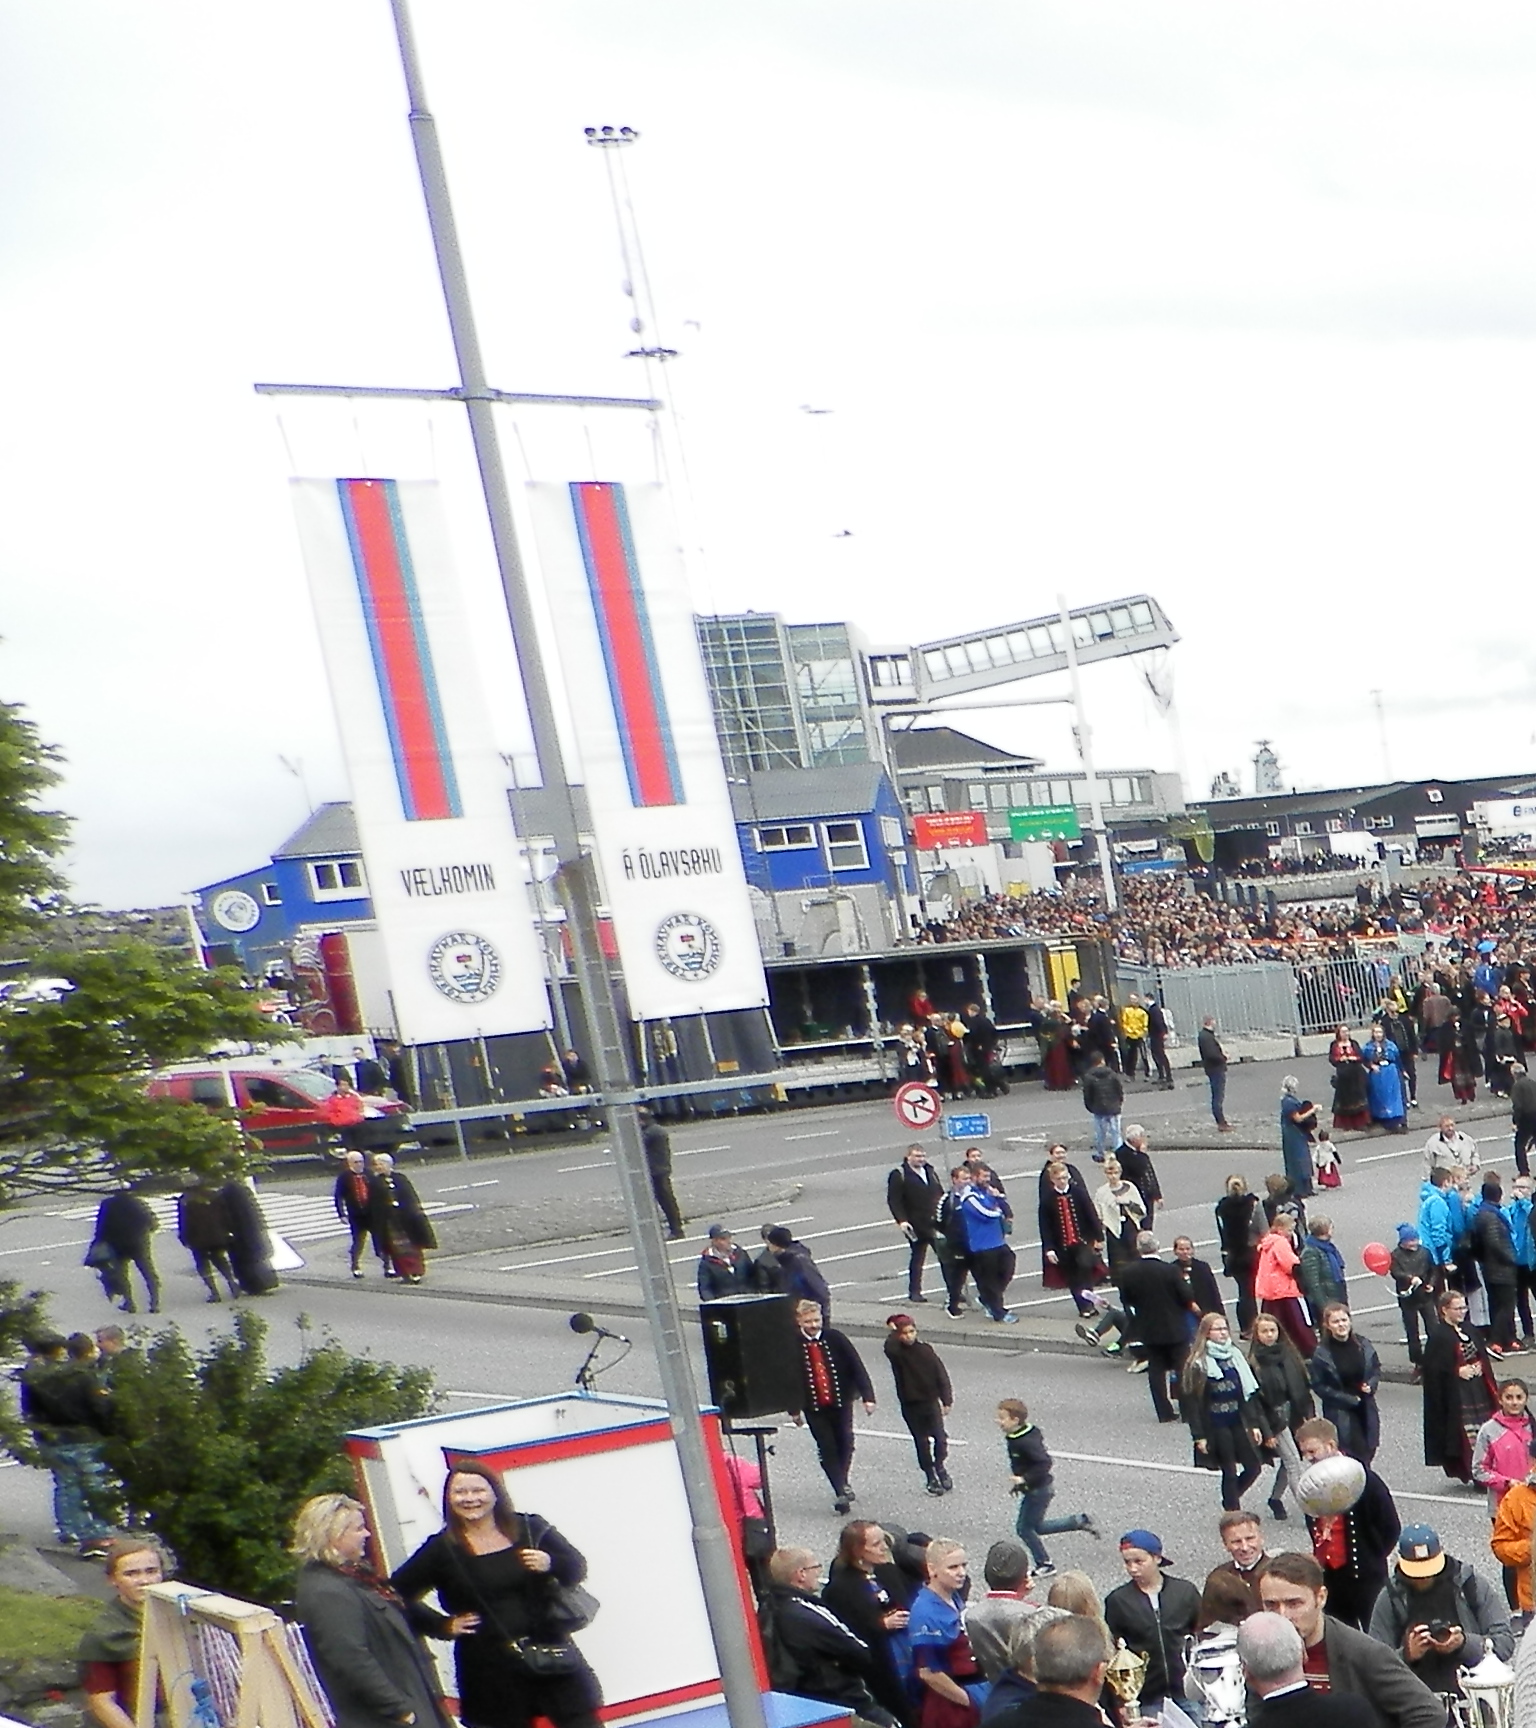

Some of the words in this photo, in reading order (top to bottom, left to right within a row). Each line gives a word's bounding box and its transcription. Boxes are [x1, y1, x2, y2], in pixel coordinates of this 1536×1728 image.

[400, 863, 496, 897] VÆLKOMIN
[622, 848, 636, 880] Á
[638, 847, 723, 880] ÓLAVSØKU
